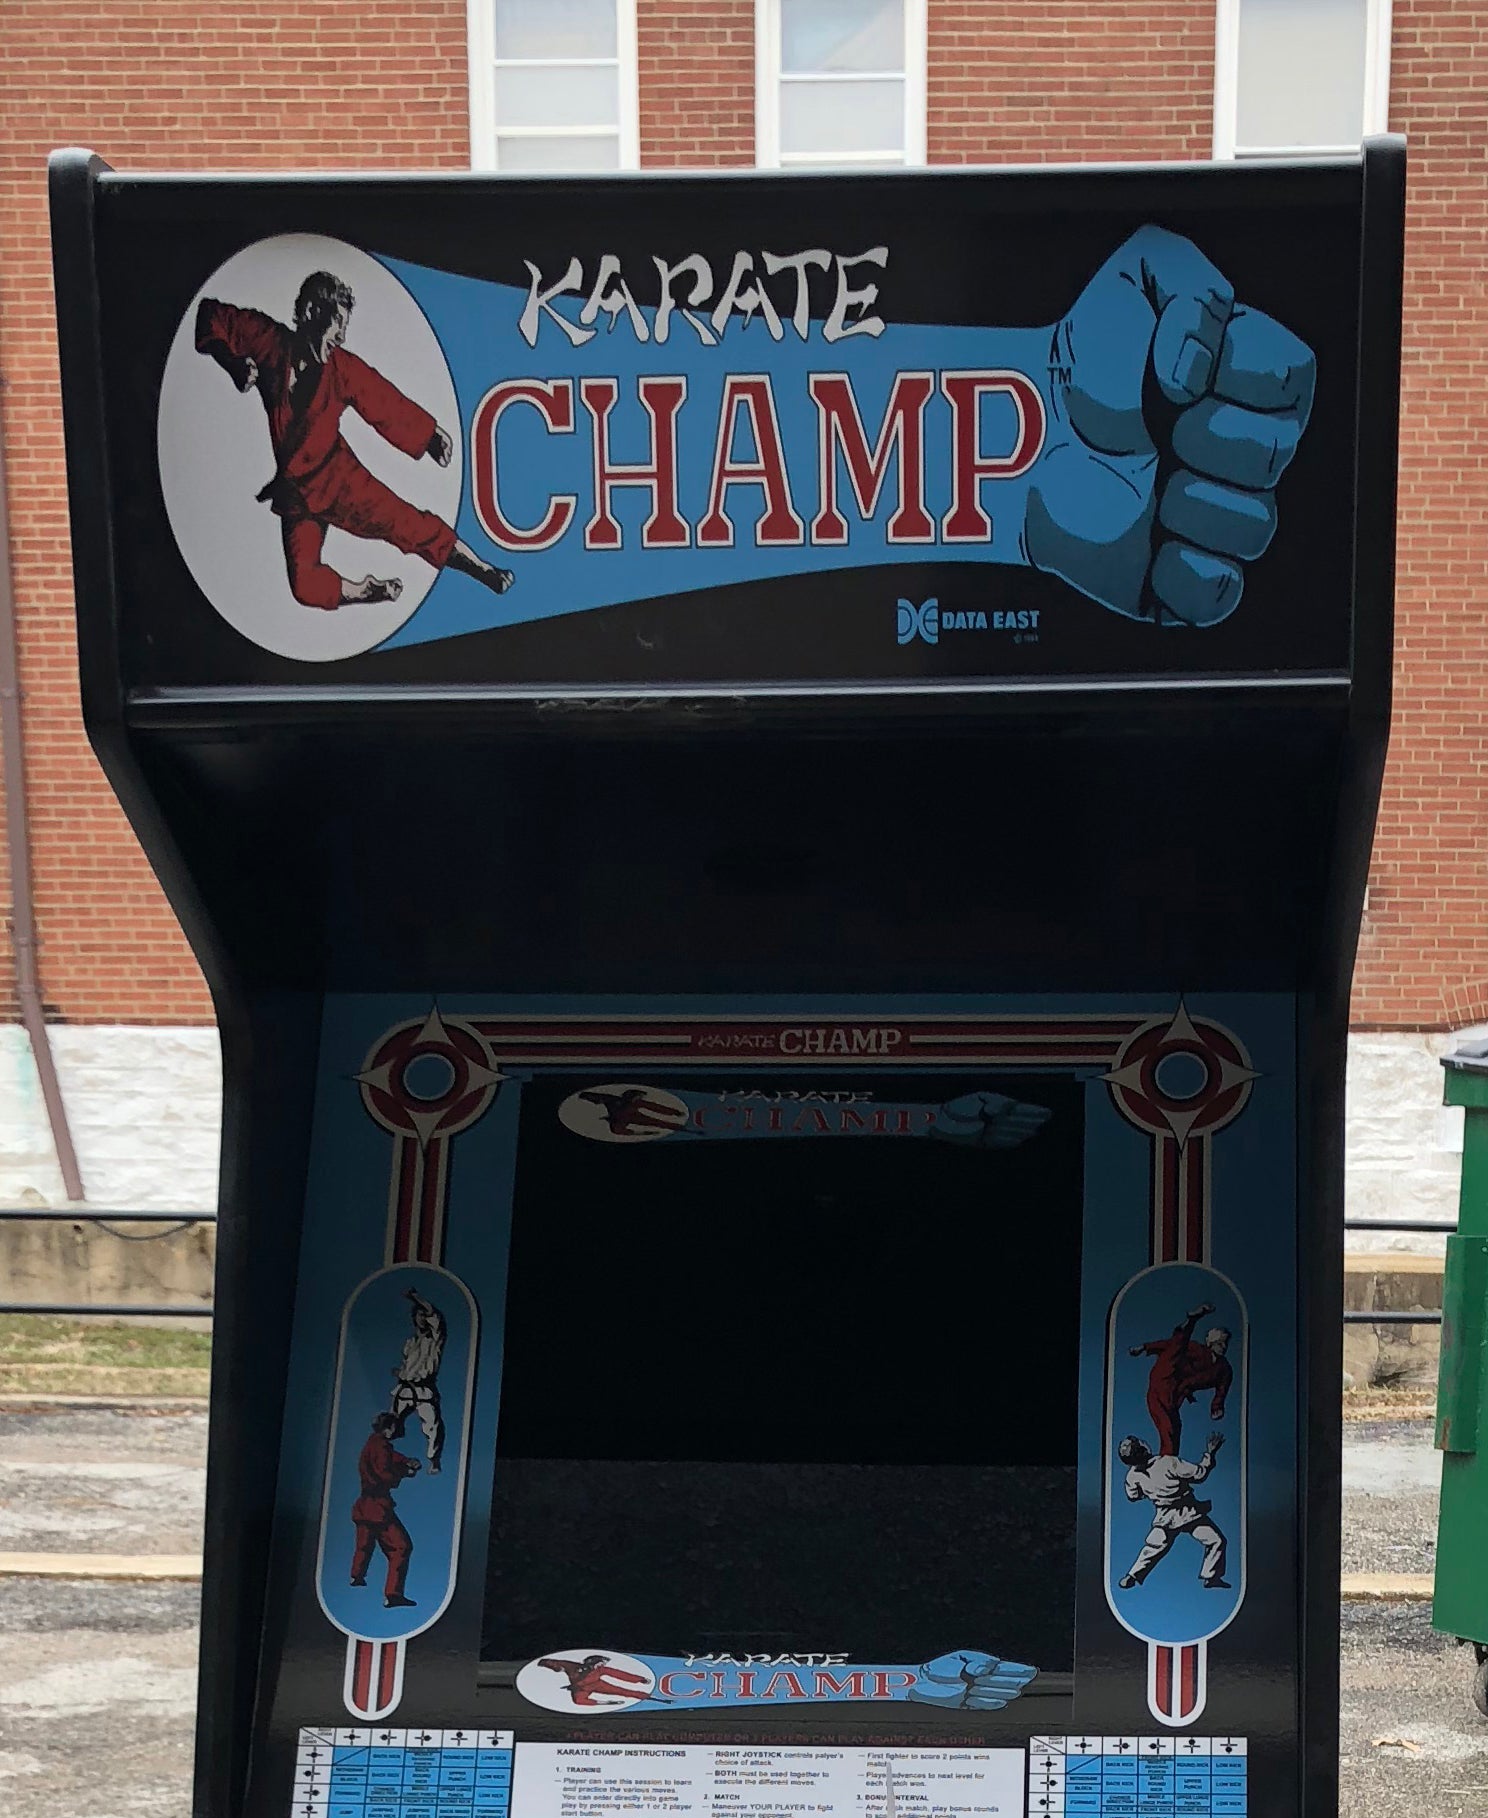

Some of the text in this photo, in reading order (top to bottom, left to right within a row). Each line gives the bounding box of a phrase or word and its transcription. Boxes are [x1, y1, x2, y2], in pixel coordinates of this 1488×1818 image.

[518, 246, 889, 348] KARATE
[470, 367, 1072, 551] CHAMP TM
[942, 611, 988, 629] DATA
[993, 610, 1040, 629] EAST
[698, 1029, 901, 1053] KARATE CHAMP
[717, 1090, 873, 1104] KARATE
[693, 1107, 938, 1134] CHAMP
[685, 1652, 849, 1668] KARATE
[657, 1671, 919, 1698] CHAMP
